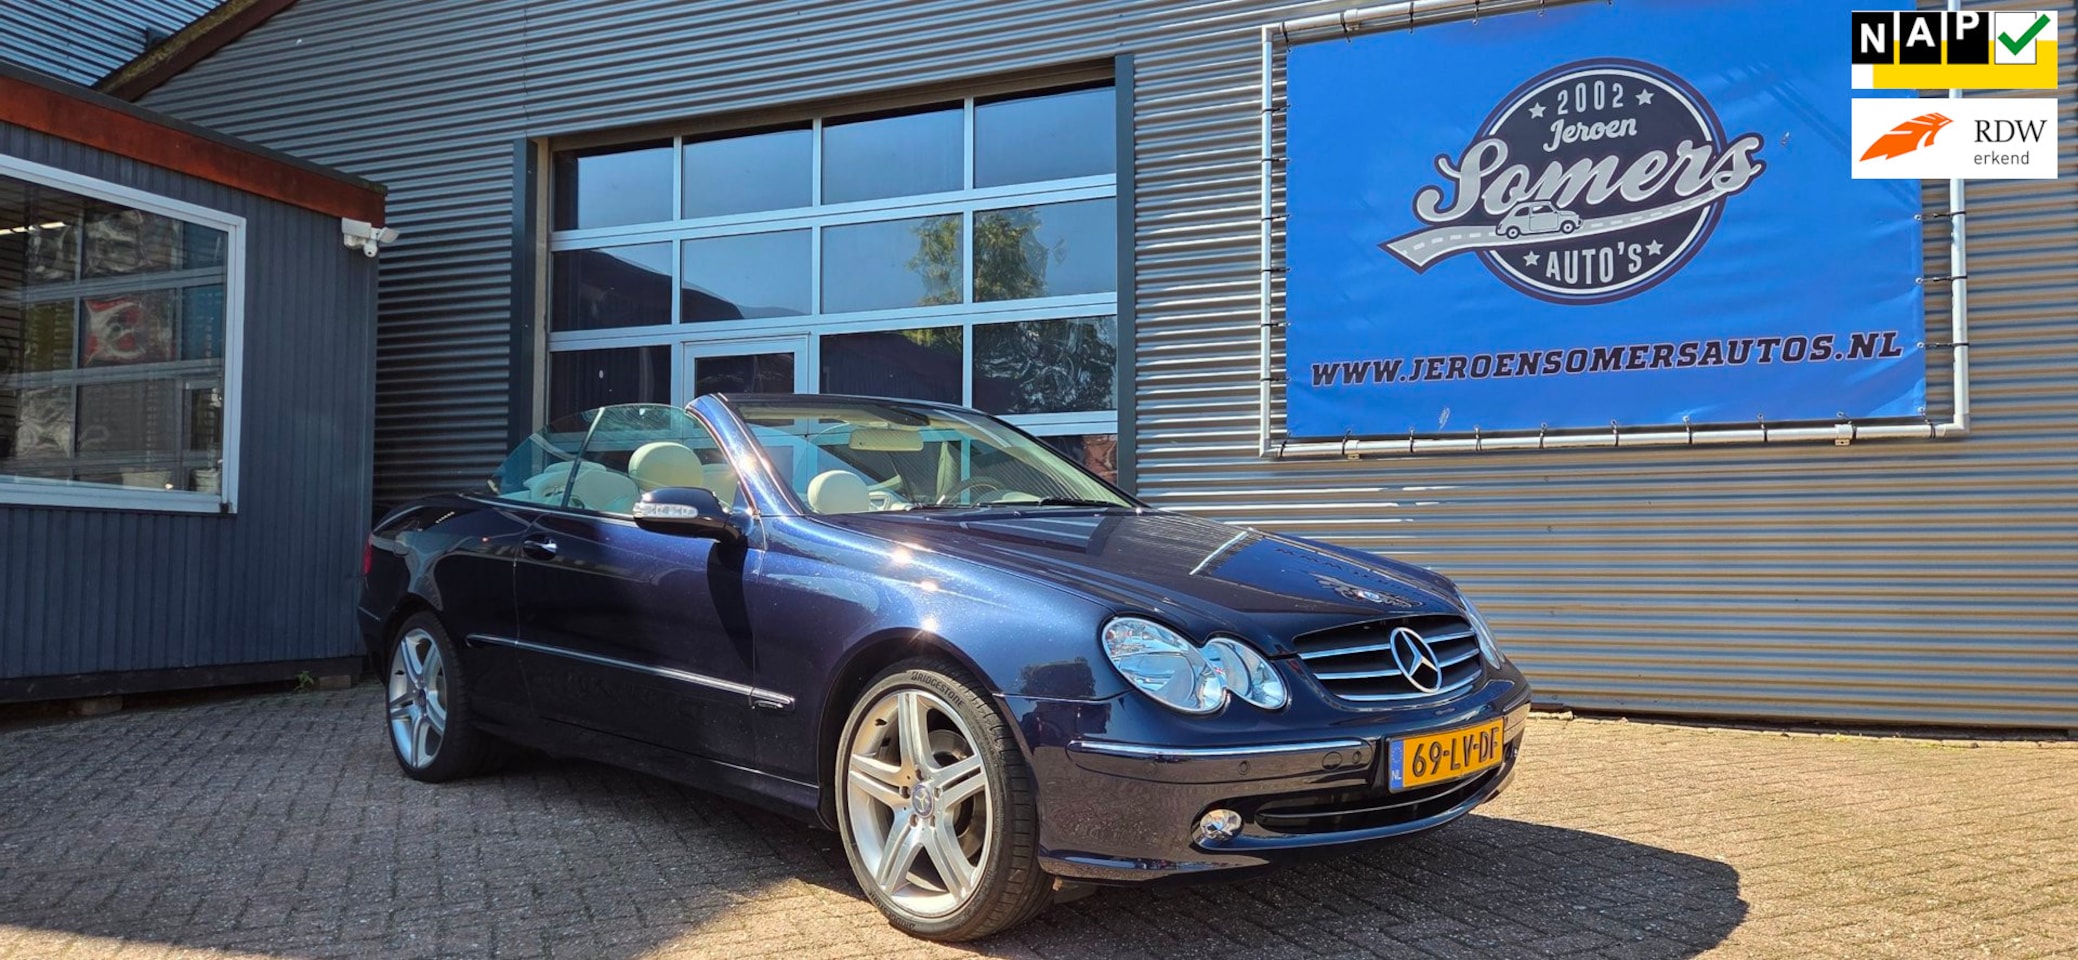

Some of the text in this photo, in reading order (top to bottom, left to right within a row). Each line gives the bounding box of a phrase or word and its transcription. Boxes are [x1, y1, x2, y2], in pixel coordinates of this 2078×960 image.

[1557, 80, 1624, 115] 2002
[1543, 116, 1637, 153] Jeroen
[1415, 136, 1764, 222] Somers
[1545, 242, 1643, 285] AUTO'S
[1311, 330, 1904, 387] WWW.JEROENSOMERSAUTOS.NL
[910, 671, 965, 708] BRIDGESTONE
[1411, 726, 1500, 778] 69-LV-DF
[1391, 770, 1402, 781] NL
